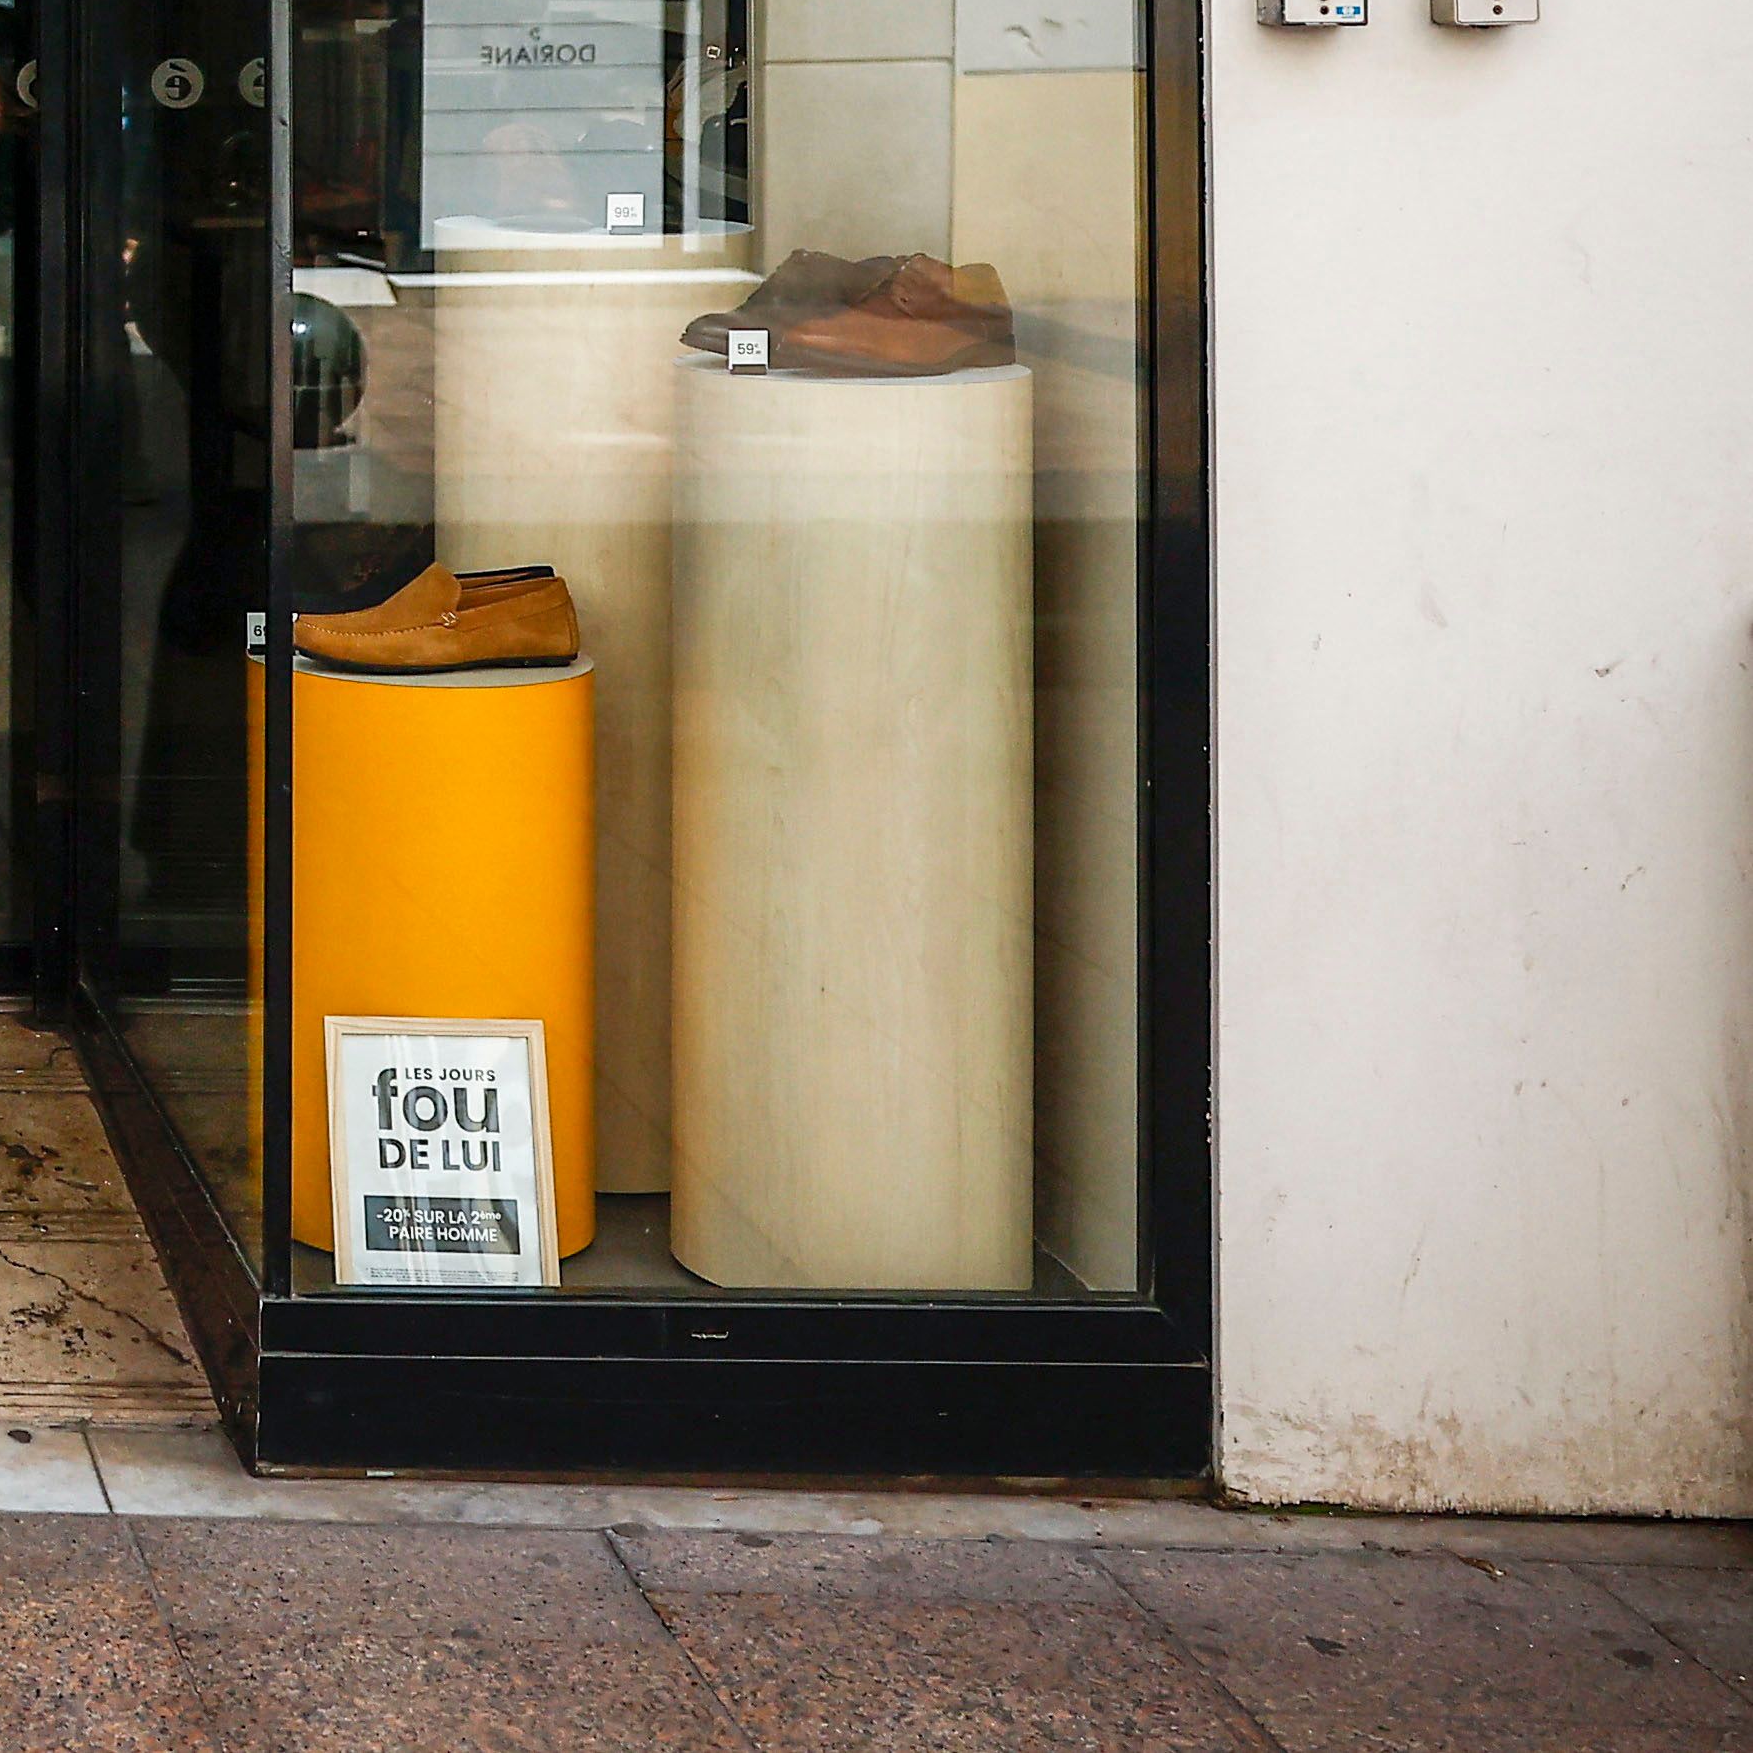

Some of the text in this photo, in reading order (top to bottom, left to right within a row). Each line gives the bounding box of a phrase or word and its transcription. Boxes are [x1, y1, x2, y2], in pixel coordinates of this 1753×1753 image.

[253, 624, 266, 637] 6
[404, 1067, 496, 1081] LES JOURS
[371, 1067, 501, 1133] fou
[378, 1137, 502, 1172] DE LUI
[413, 1209, 446, 1225] SUR
[448, 1211, 468, 1225] LA
[389, 1225, 434, 1240] PAIRE
